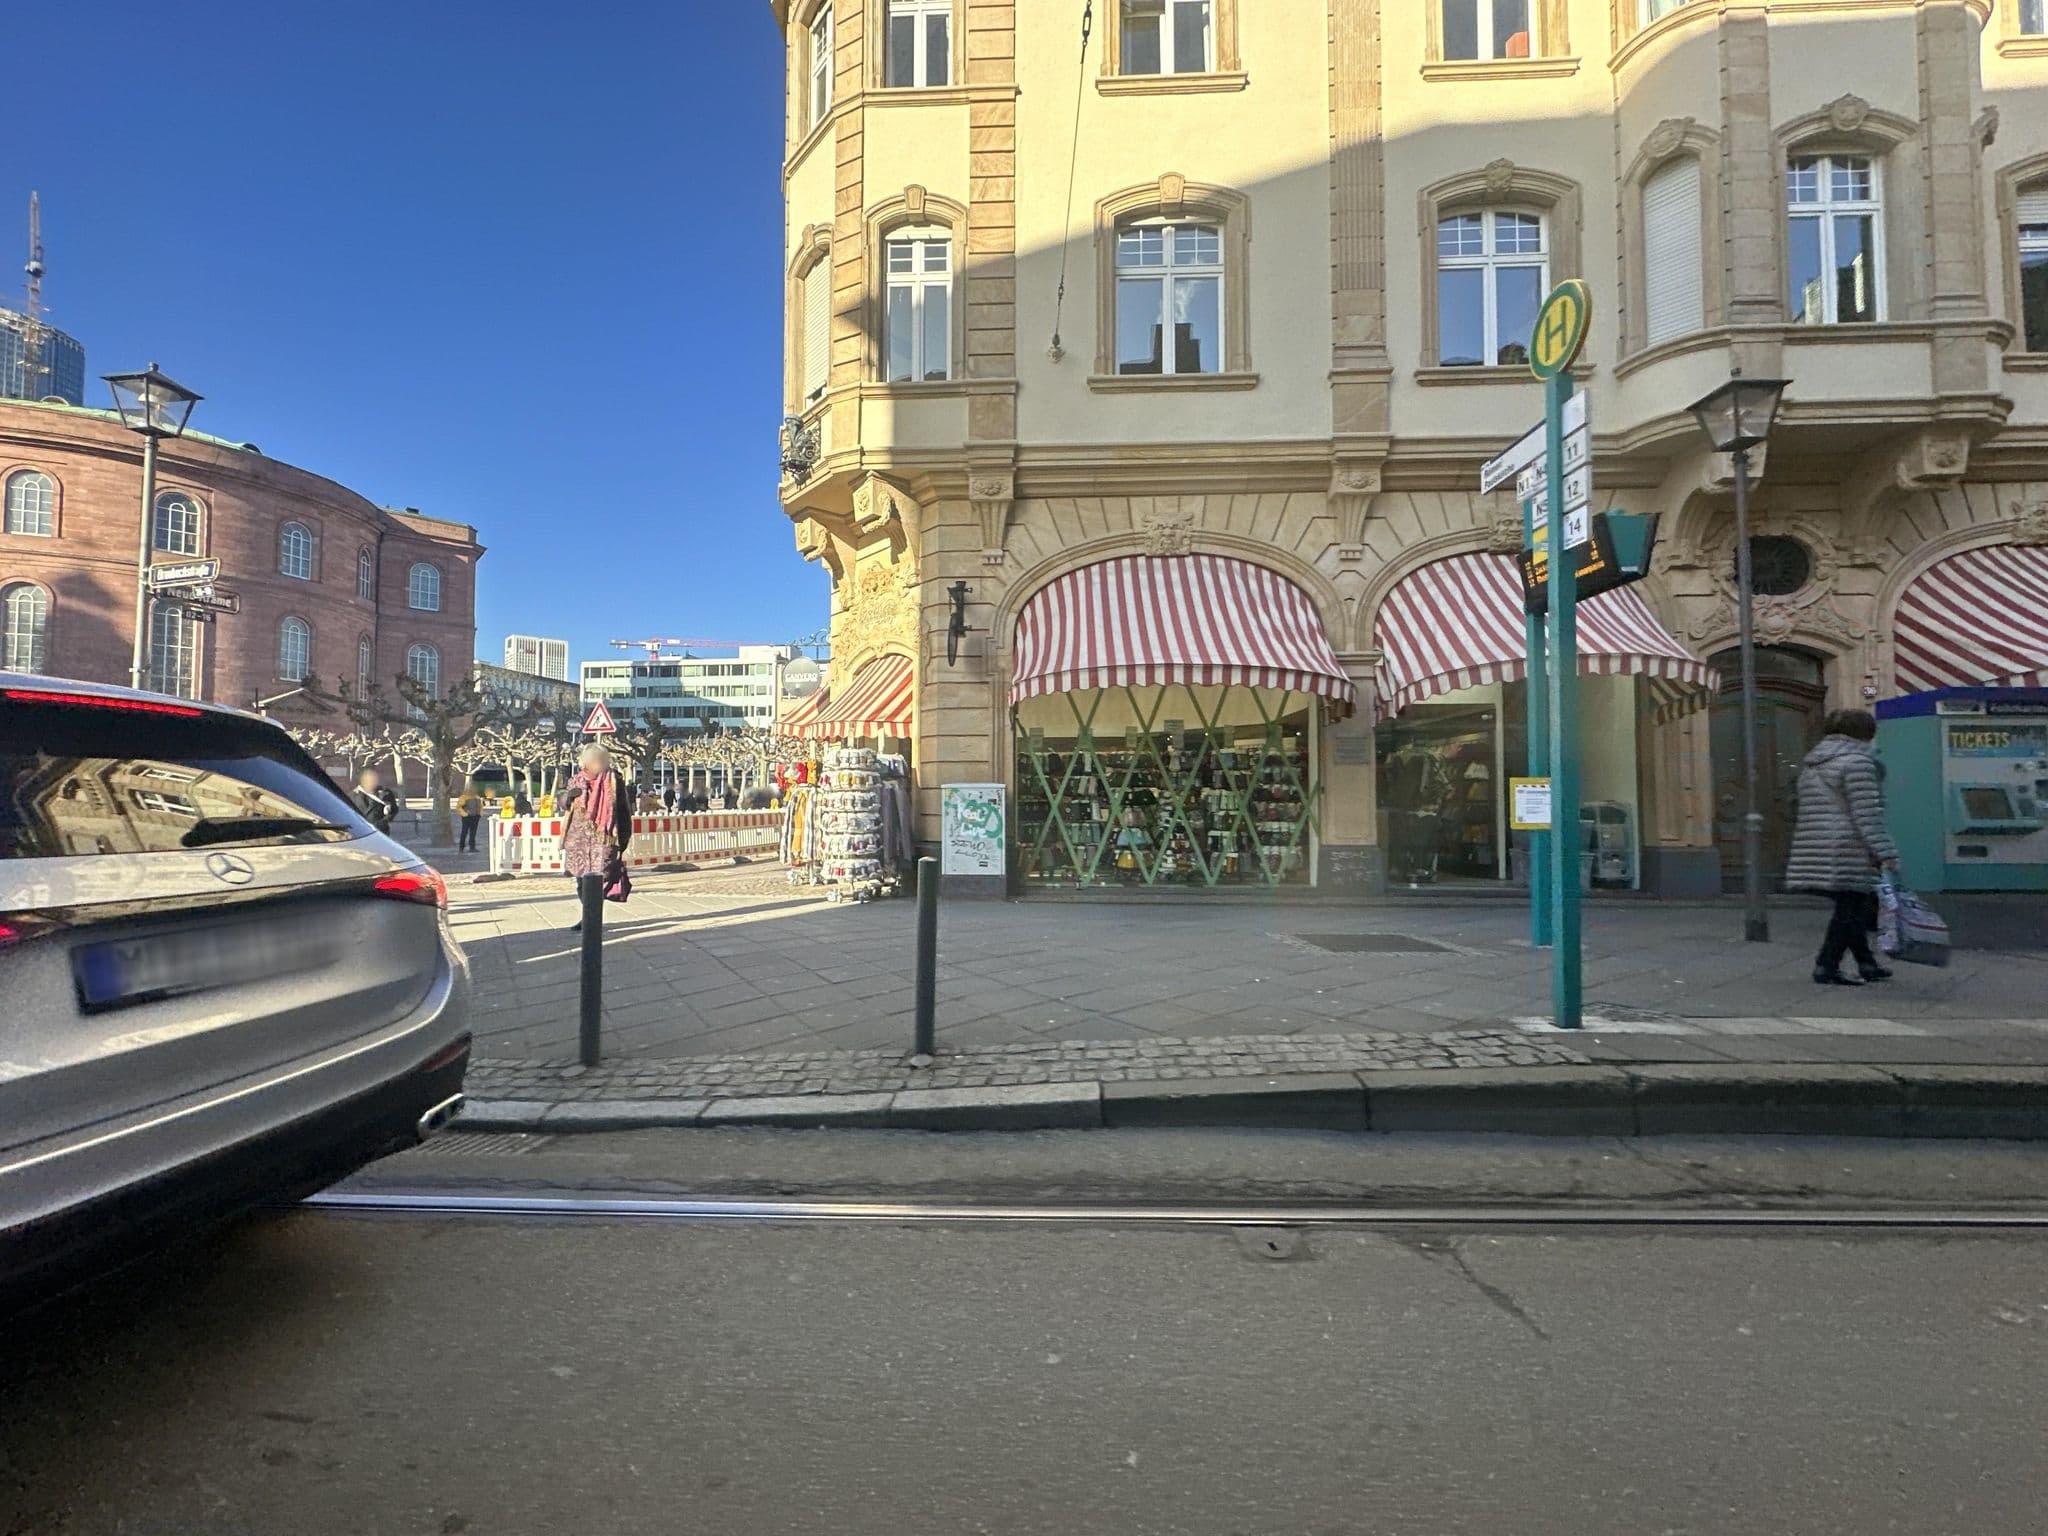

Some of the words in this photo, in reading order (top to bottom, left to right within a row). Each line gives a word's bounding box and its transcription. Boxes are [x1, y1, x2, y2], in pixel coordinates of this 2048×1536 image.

[1545, 299, 1567, 363] H
[1567, 441, 1578, 460] 11
[1567, 480, 1579, 498] 12
[1569, 517, 1582, 536] 14
[1951, 731, 2011, 748] TICKETS
